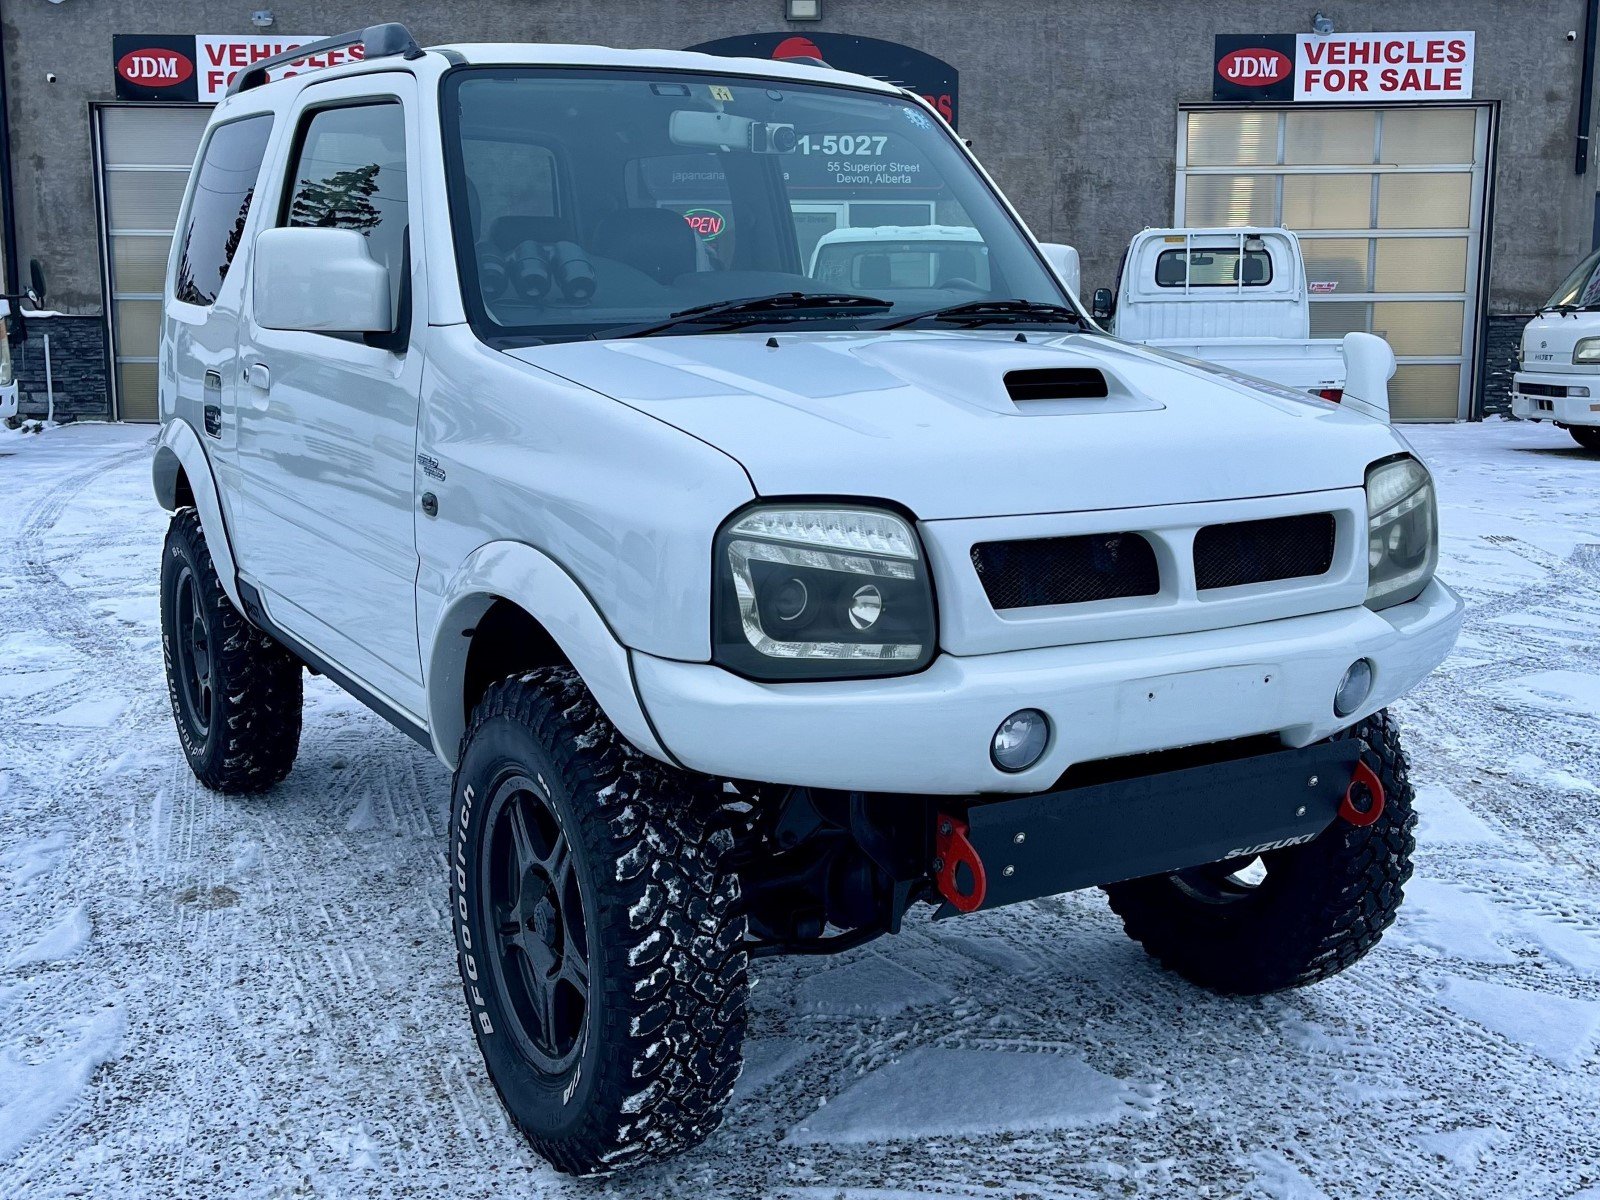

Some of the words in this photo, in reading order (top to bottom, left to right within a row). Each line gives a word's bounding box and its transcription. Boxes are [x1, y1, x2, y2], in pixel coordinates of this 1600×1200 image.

[1304, 40, 1466, 64] VEHICLES
[126, 57, 178, 78] JDM
[1228, 56, 1278, 78] JDM
[1304, 69, 1369, 92] FOR
[1380, 68, 1462, 91] SALE
[827, 162, 840, 172] 55
[843, 161, 887, 173] Superior
[889, 162, 920, 173] Street
[836, 173, 873, 185] Devon,
[875, 173, 912, 184] Alberta
[1223, 832, 1316, 860] SUZUKI
[456, 783, 495, 1035] BFGoodrich
